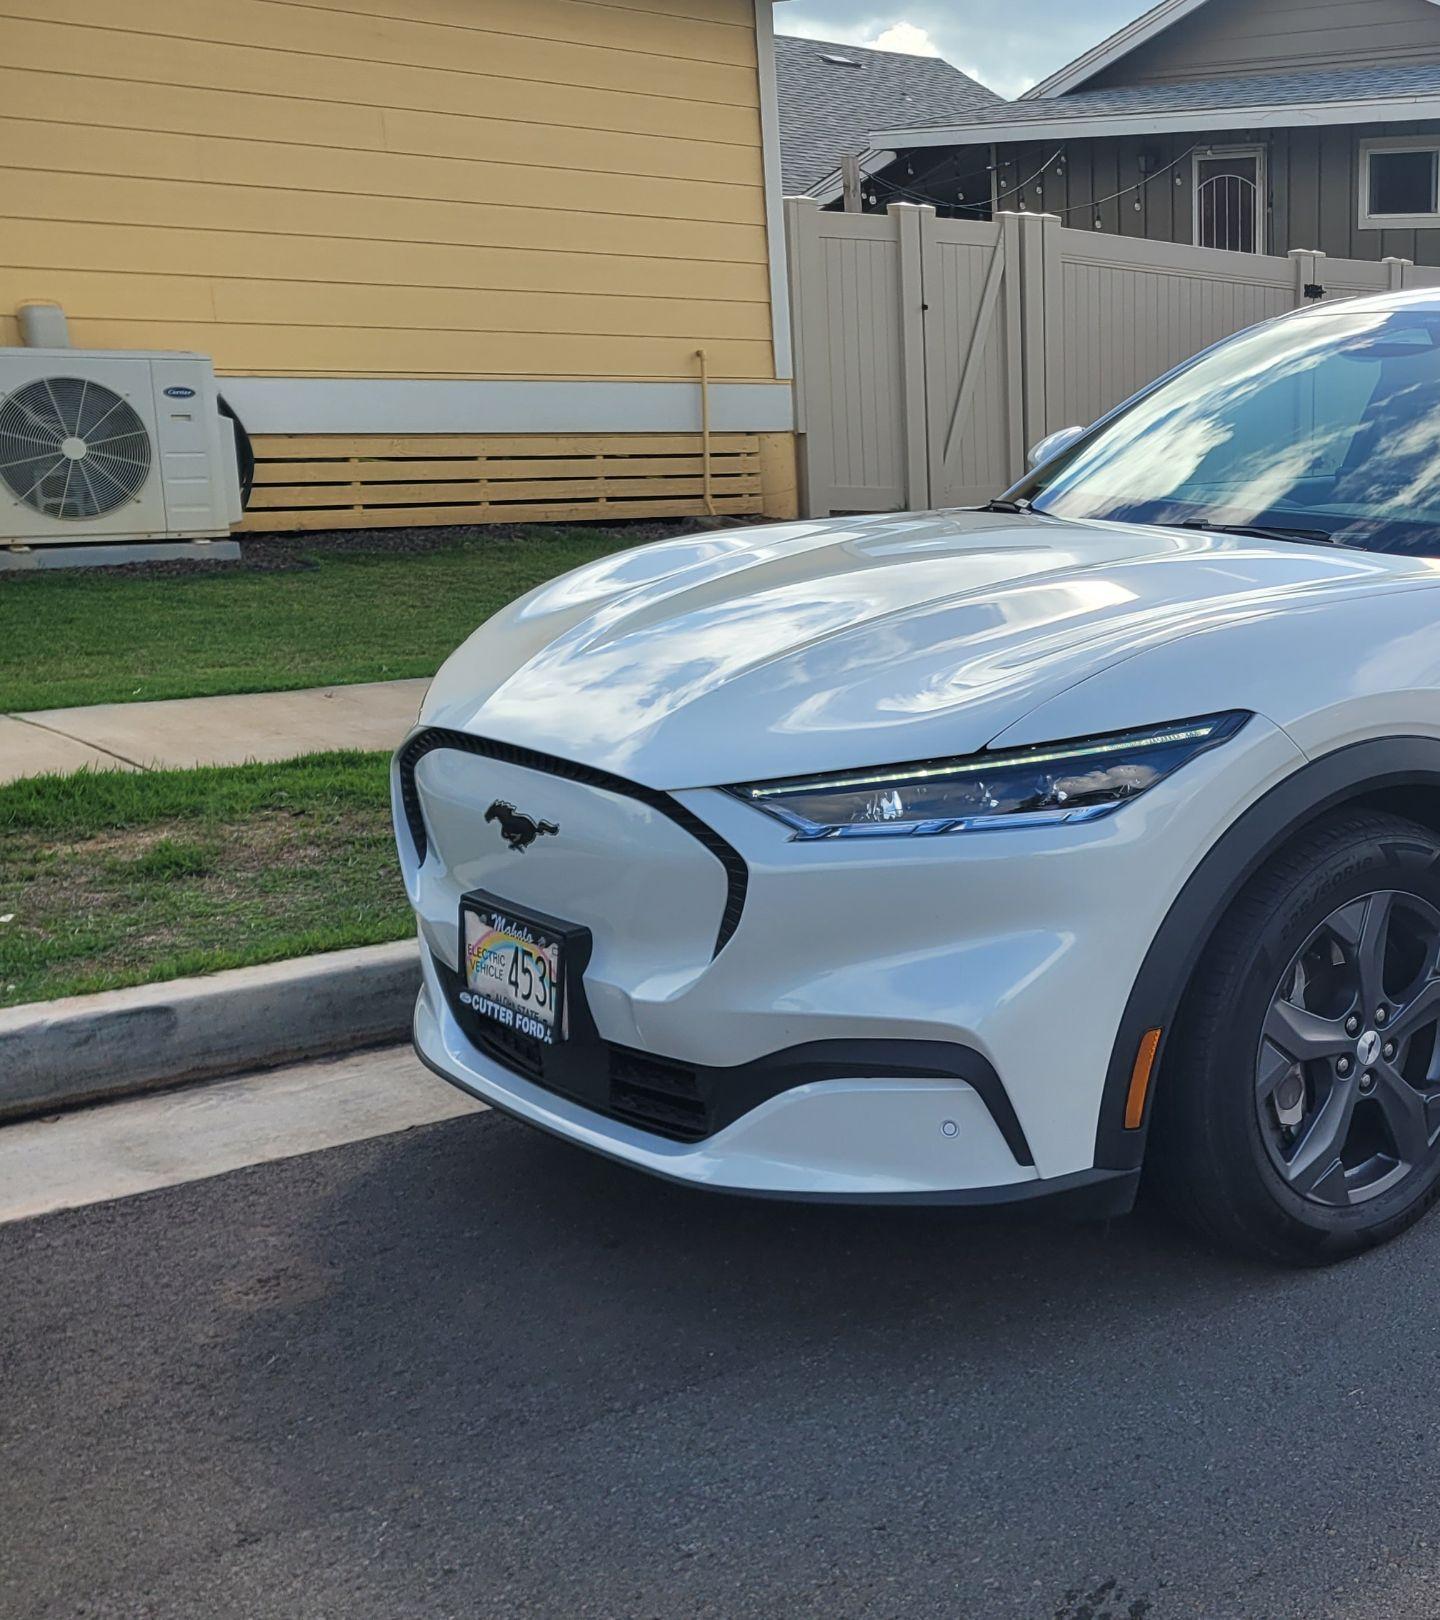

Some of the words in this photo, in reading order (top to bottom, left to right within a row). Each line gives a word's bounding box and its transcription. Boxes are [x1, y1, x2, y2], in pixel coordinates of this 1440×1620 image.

[467, 944, 505, 966] ELECTRIC
[470, 959, 503, 981] VEHICLE
[472, 994, 513, 1026] CUTTER
[516, 1014, 544, 1037] FORD
